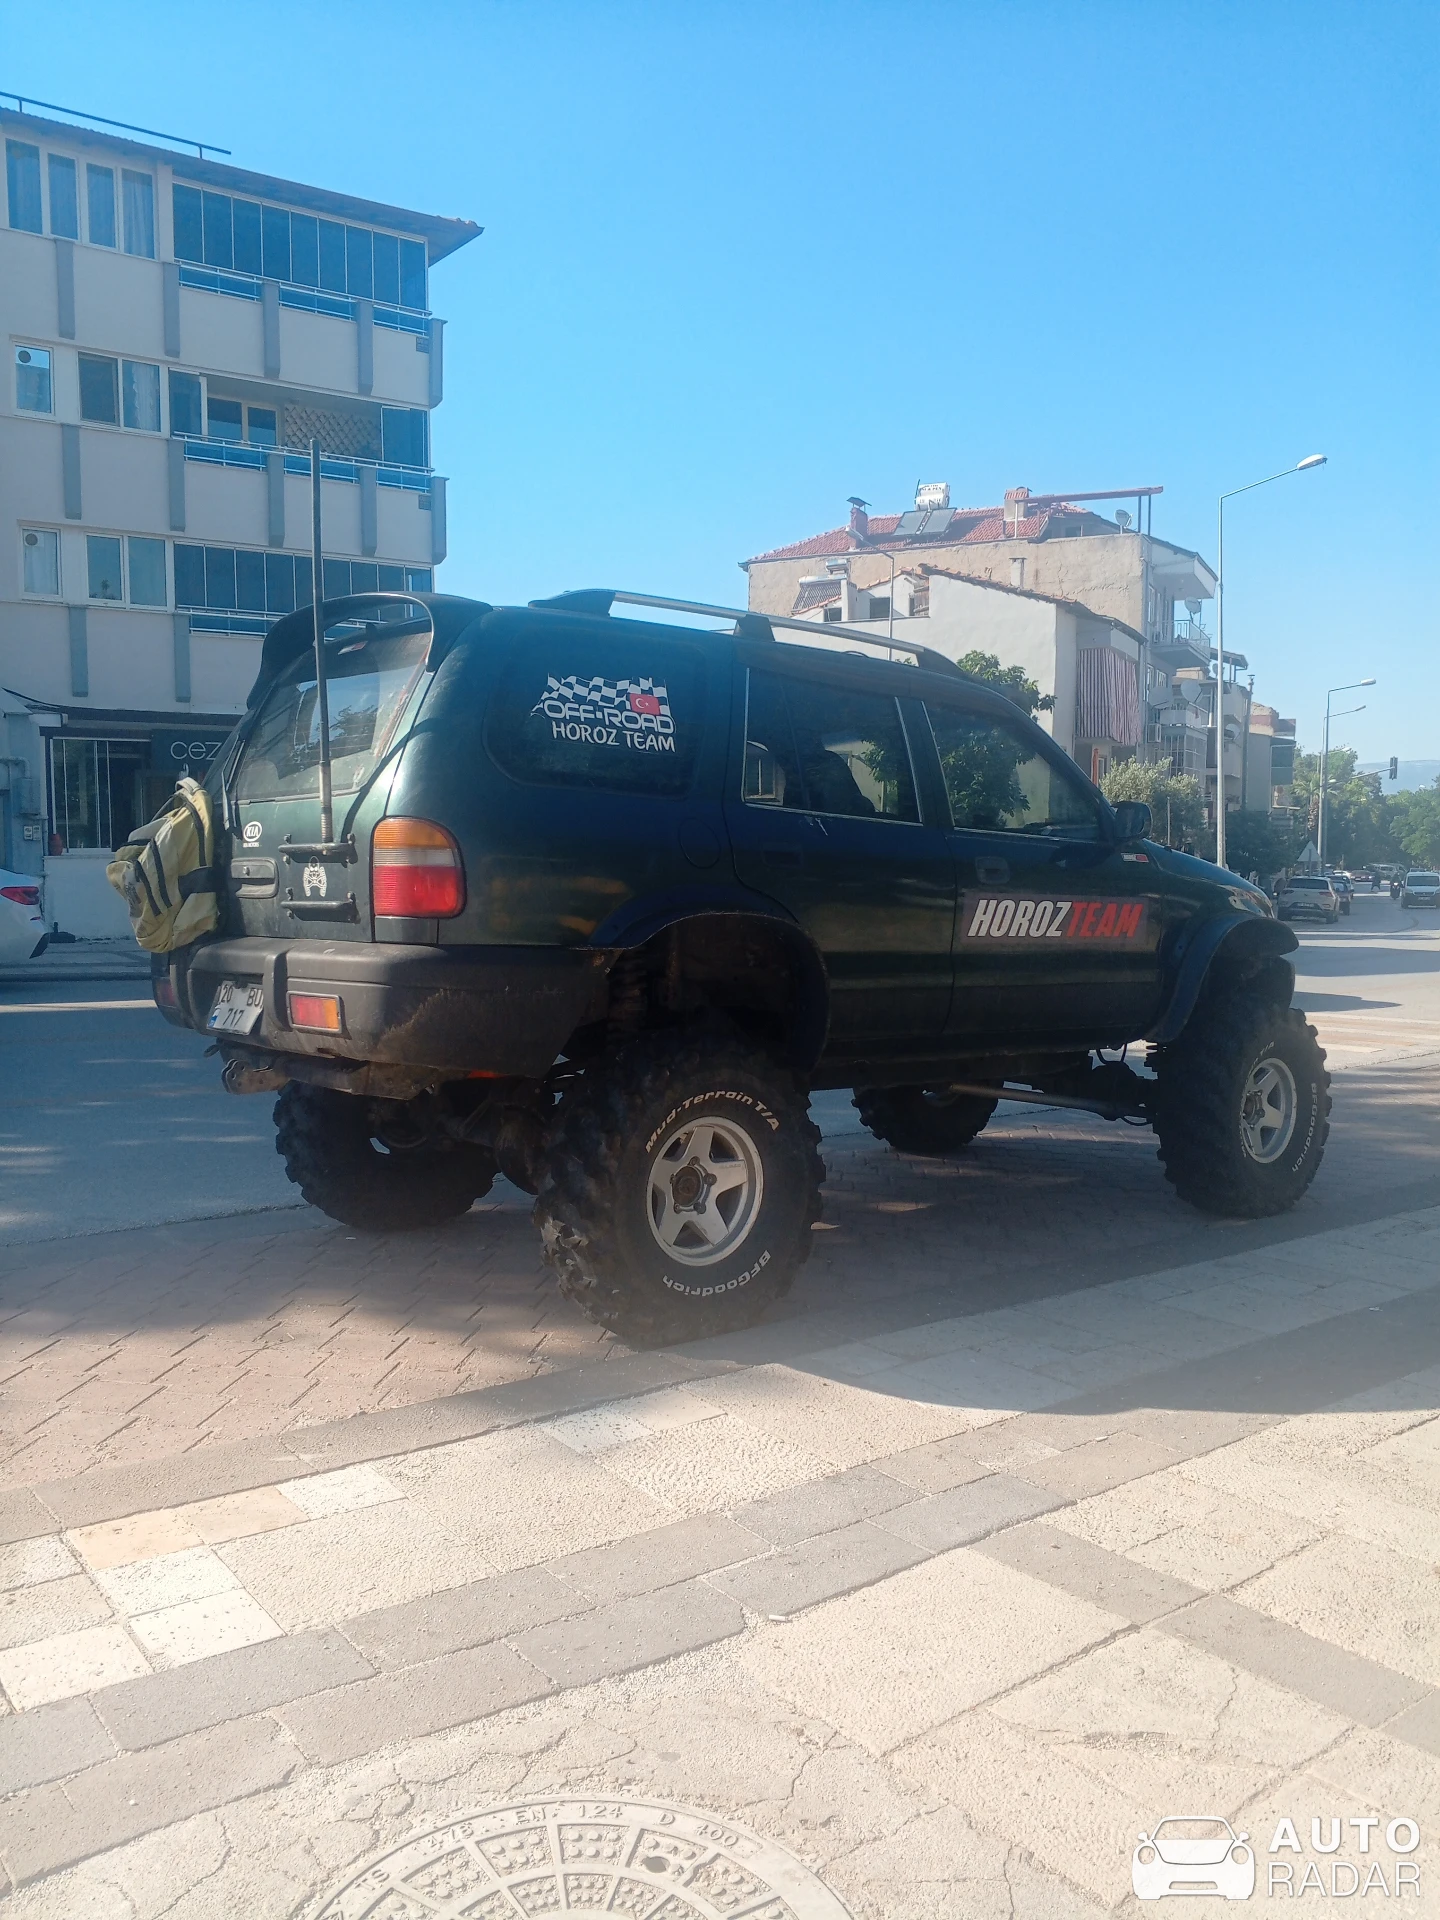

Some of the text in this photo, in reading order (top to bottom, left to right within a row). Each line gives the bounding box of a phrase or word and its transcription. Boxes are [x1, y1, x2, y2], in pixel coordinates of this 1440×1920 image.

[543, 700, 675, 734] OFF-ROAD
[552, 721, 676, 753] HOROZ TEAM
[221, 984, 233, 1003] 20
[222, 1008, 245, 1028] 717
[644, 1090, 781, 1154] Mud-Terrain T/A
[1291, 1082, 1319, 1173] BFGoodrich
[662, 1249, 772, 1297] BFGoodrich
[513, 1807, 547, 1825] EN
[578, 1803, 623, 1819] 124
[657, 1811, 676, 1826] D
[695, 1822, 739, 1848] 400
